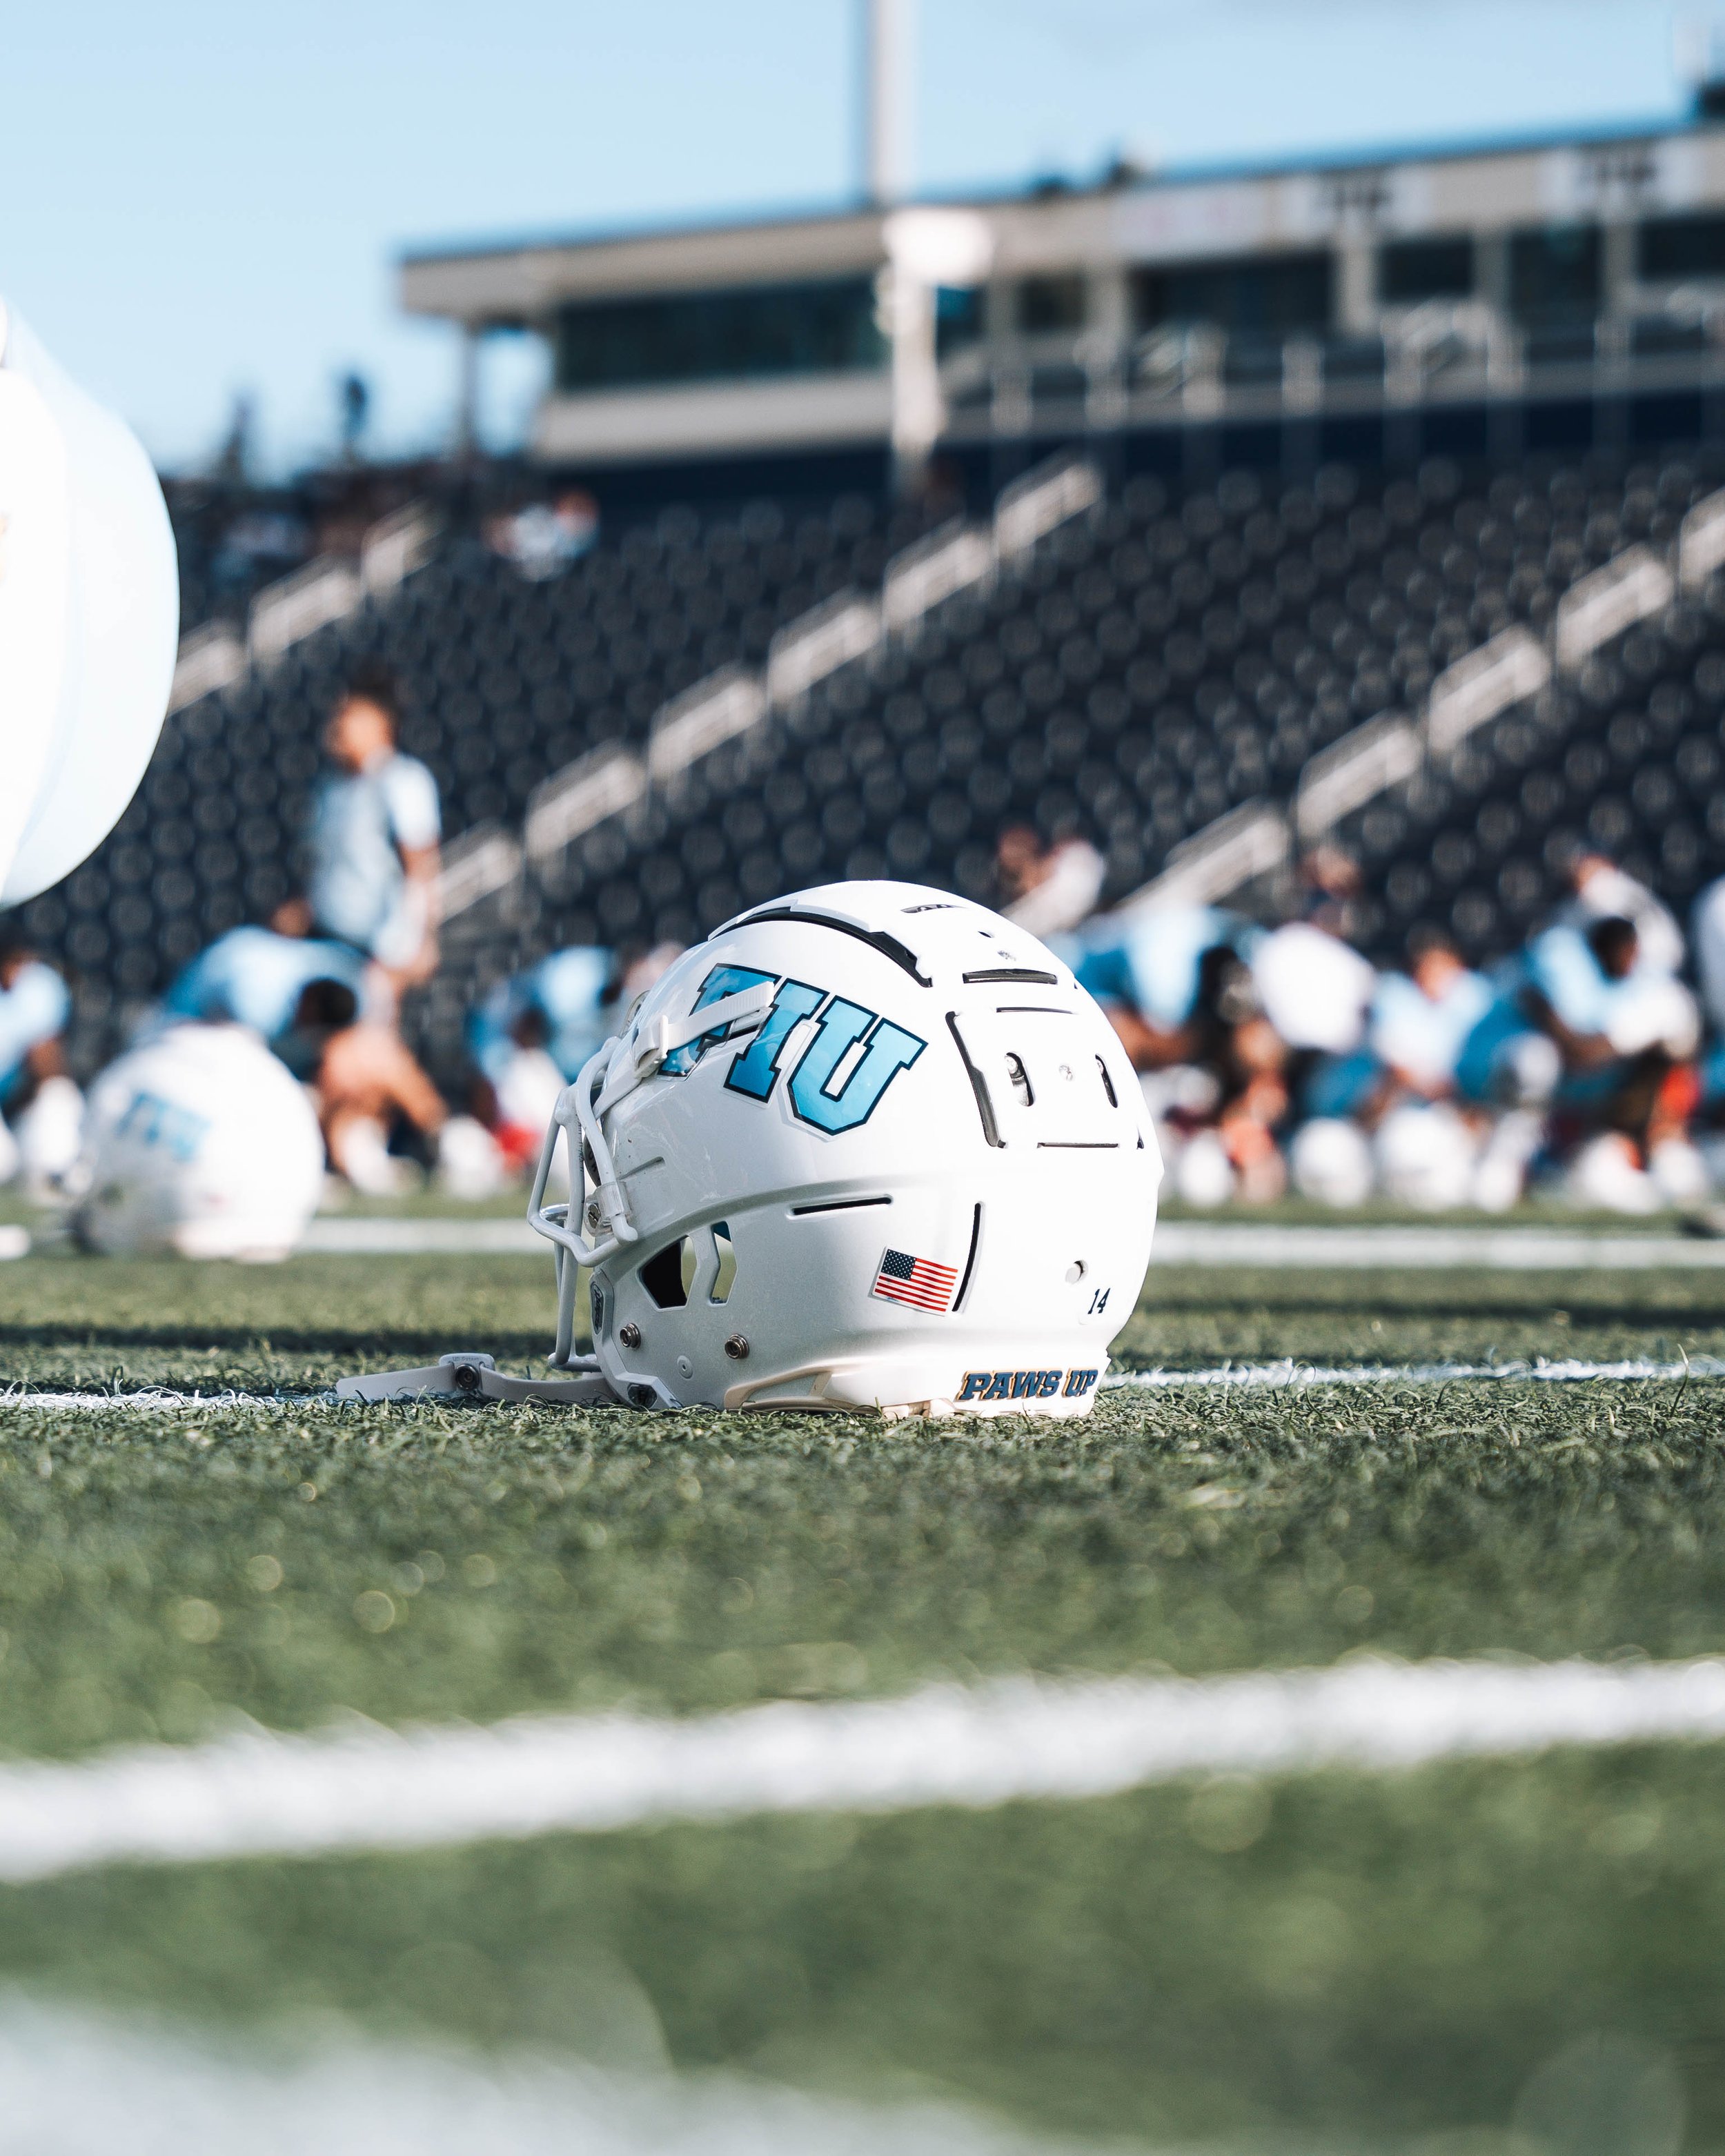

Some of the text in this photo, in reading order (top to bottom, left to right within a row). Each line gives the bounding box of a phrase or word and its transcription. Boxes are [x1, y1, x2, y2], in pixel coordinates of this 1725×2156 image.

[1087, 1287, 1111, 1314] 14
[955, 1367, 1098, 1402] PAWS UP
